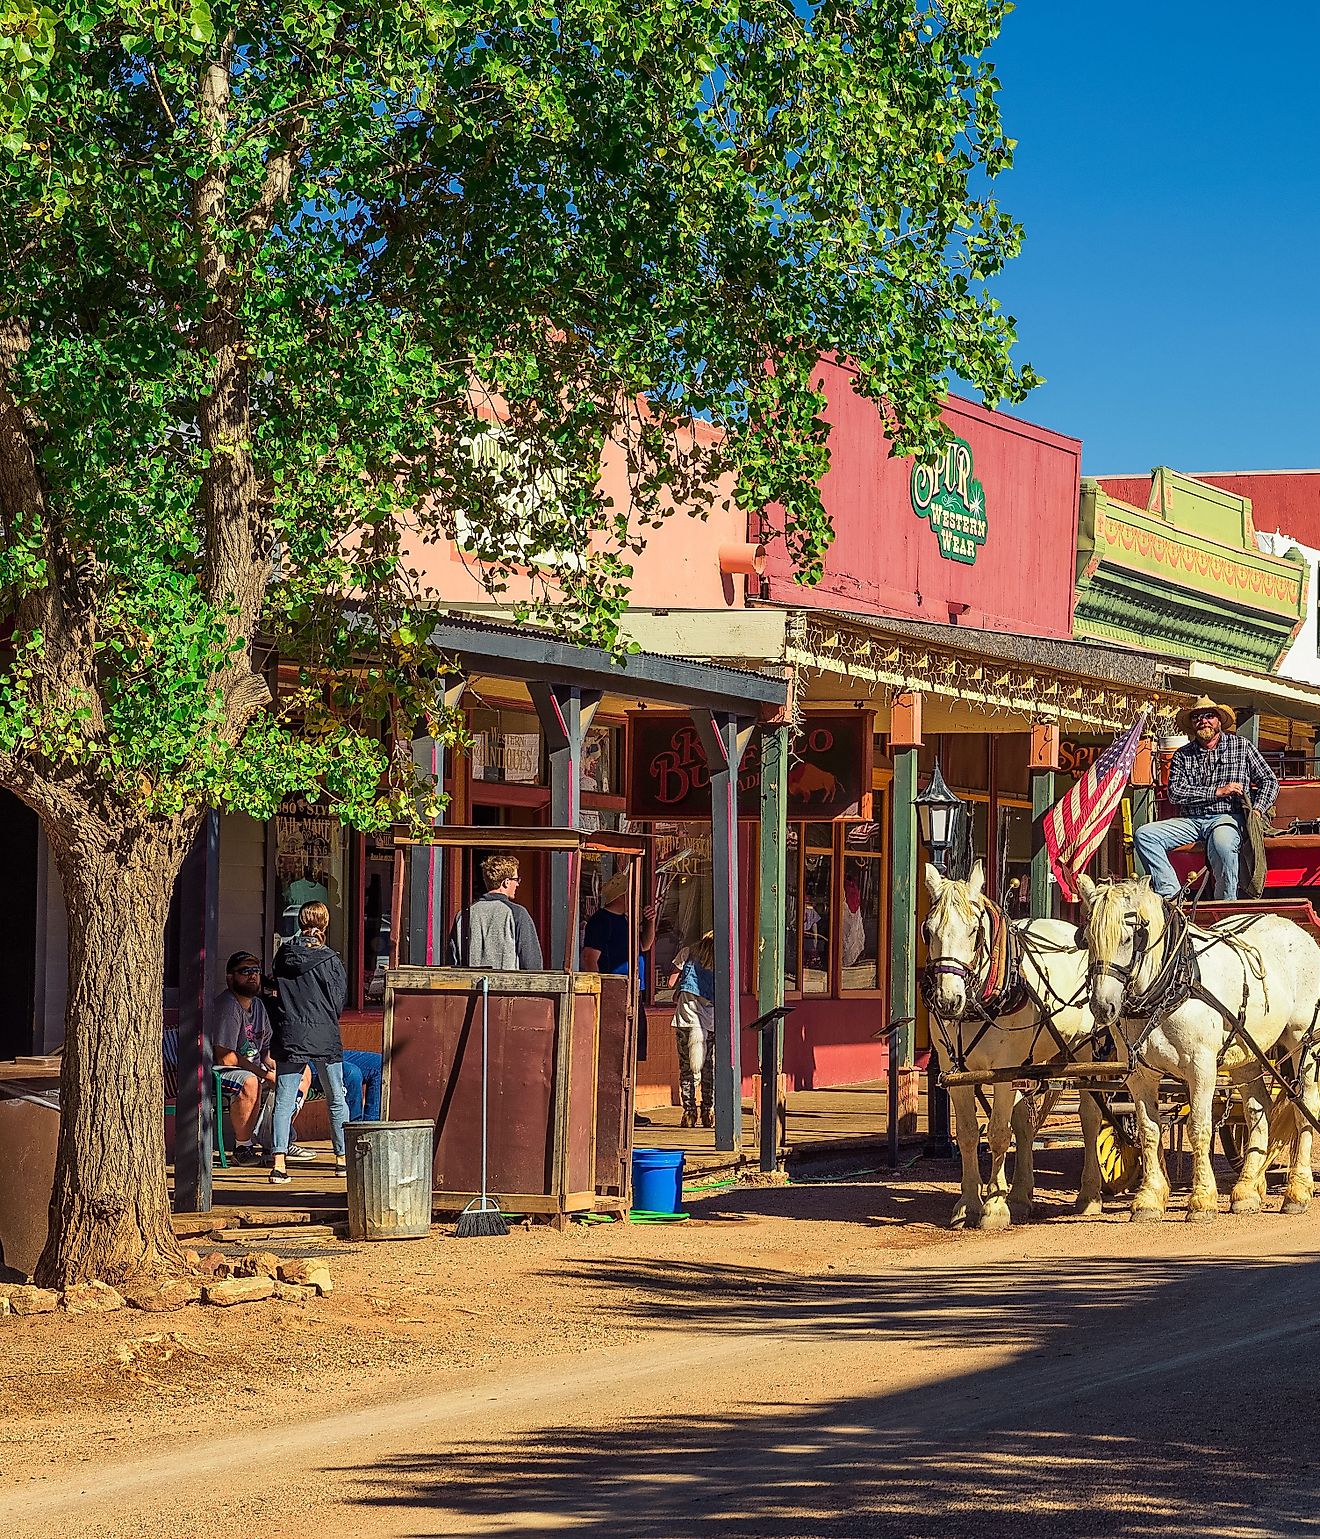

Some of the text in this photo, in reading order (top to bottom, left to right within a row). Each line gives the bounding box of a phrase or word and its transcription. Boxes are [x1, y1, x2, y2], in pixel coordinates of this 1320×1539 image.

[914, 441, 970, 509] SPUR
[930, 502, 987, 538] WESTERN
[941, 529, 976, 558] WEAR
[1060, 741, 1101, 772] SPU
